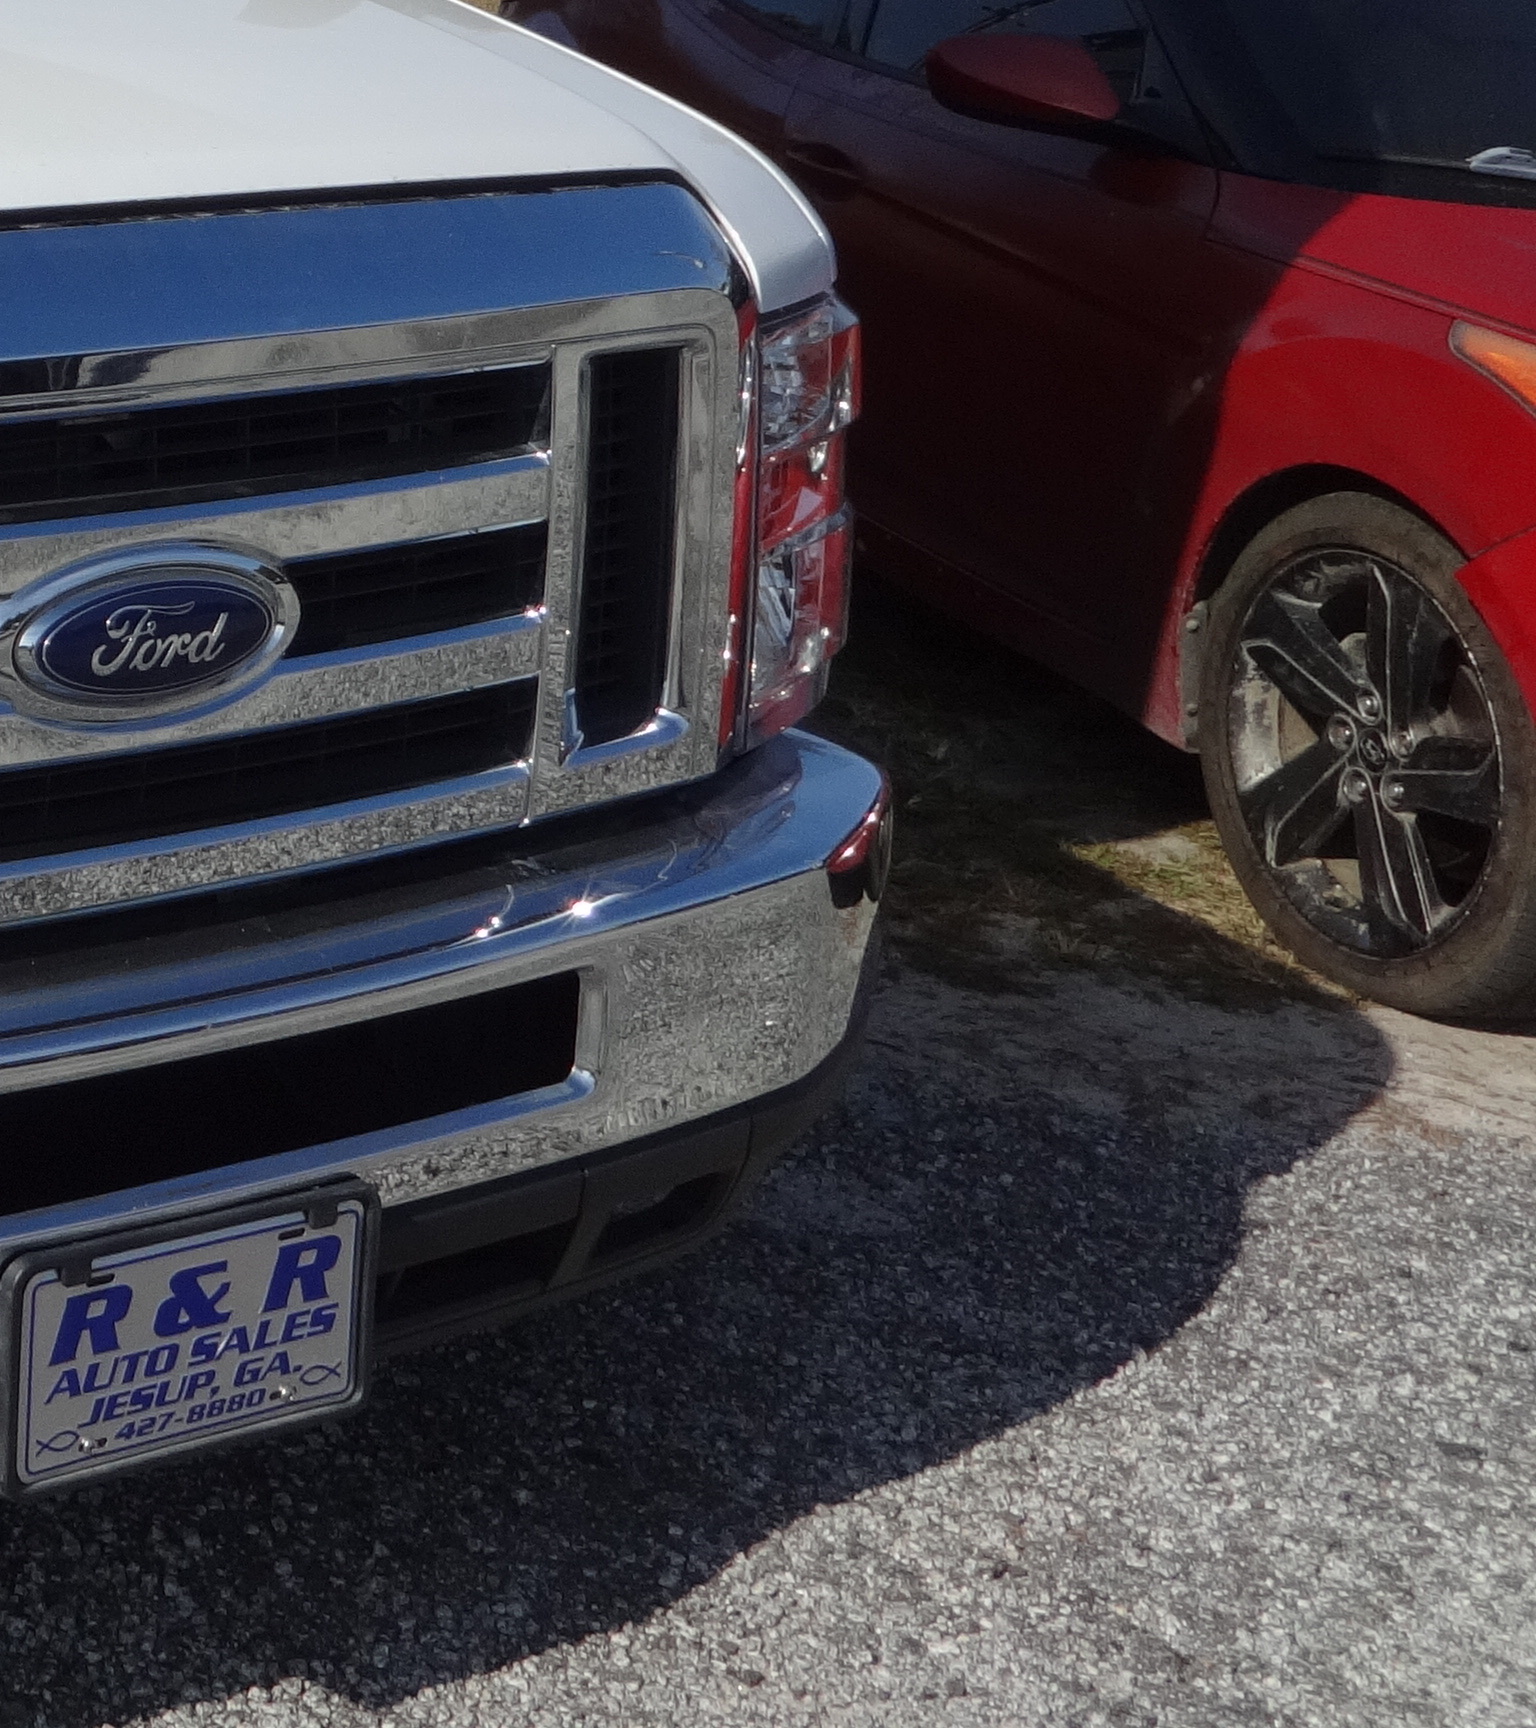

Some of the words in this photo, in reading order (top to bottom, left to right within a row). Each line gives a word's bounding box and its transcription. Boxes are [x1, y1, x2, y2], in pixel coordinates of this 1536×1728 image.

[91, 601, 228, 676] Ford
[48, 1284, 132, 1367] R
[153, 1261, 232, 1338] &
[260, 1235, 341, 1313] R
[45, 1343, 179, 1404] AUTO
[188, 1304, 339, 1368] SALES
[78, 1373, 219, 1428] JESUP,
[234, 1350, 302, 1386] GA.
[114, 1388, 266, 1441] 427-8880
